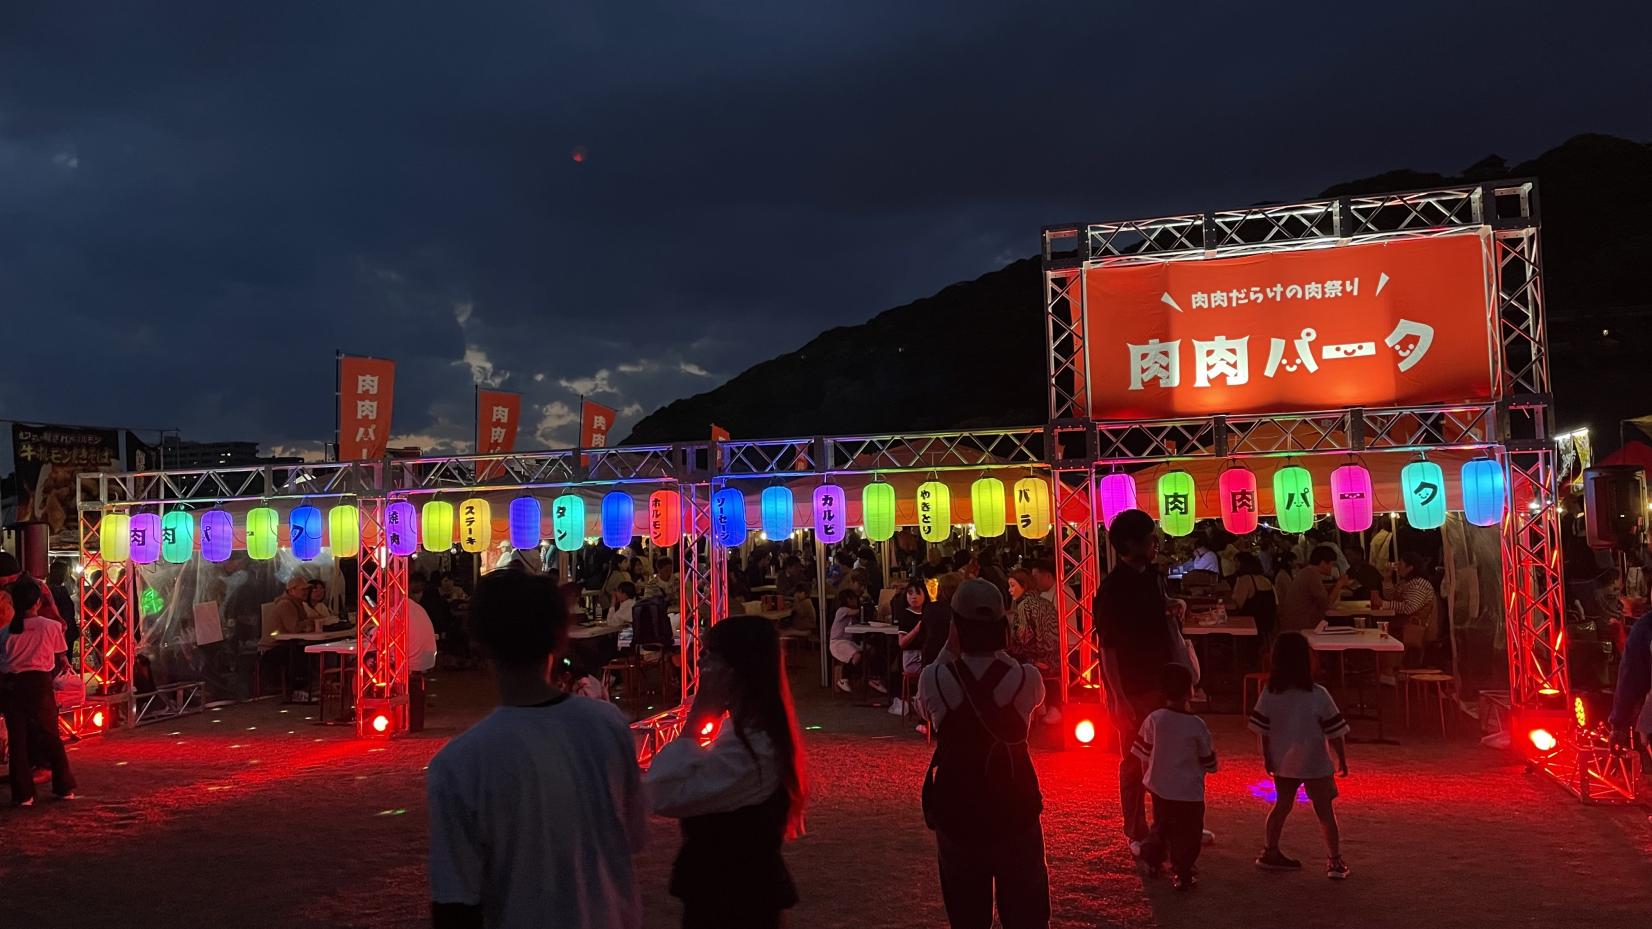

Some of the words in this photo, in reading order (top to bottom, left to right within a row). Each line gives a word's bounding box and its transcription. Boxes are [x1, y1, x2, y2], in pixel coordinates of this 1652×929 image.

[1190, 276, 1360, 309] 肉肉だらけの肉祭り
[1127, 318, 1435, 391] 肉肉パーク
[651, 497, 662, 539] ホルモン
[920, 490, 932, 535] やきとり
[1163, 492, 1188, 515] 肉
[1231, 489, 1256, 513] 肉
[388, 511, 400, 546] 焼肉
[464, 505, 476, 545] ステーキ
[556, 506, 567, 541] タン
